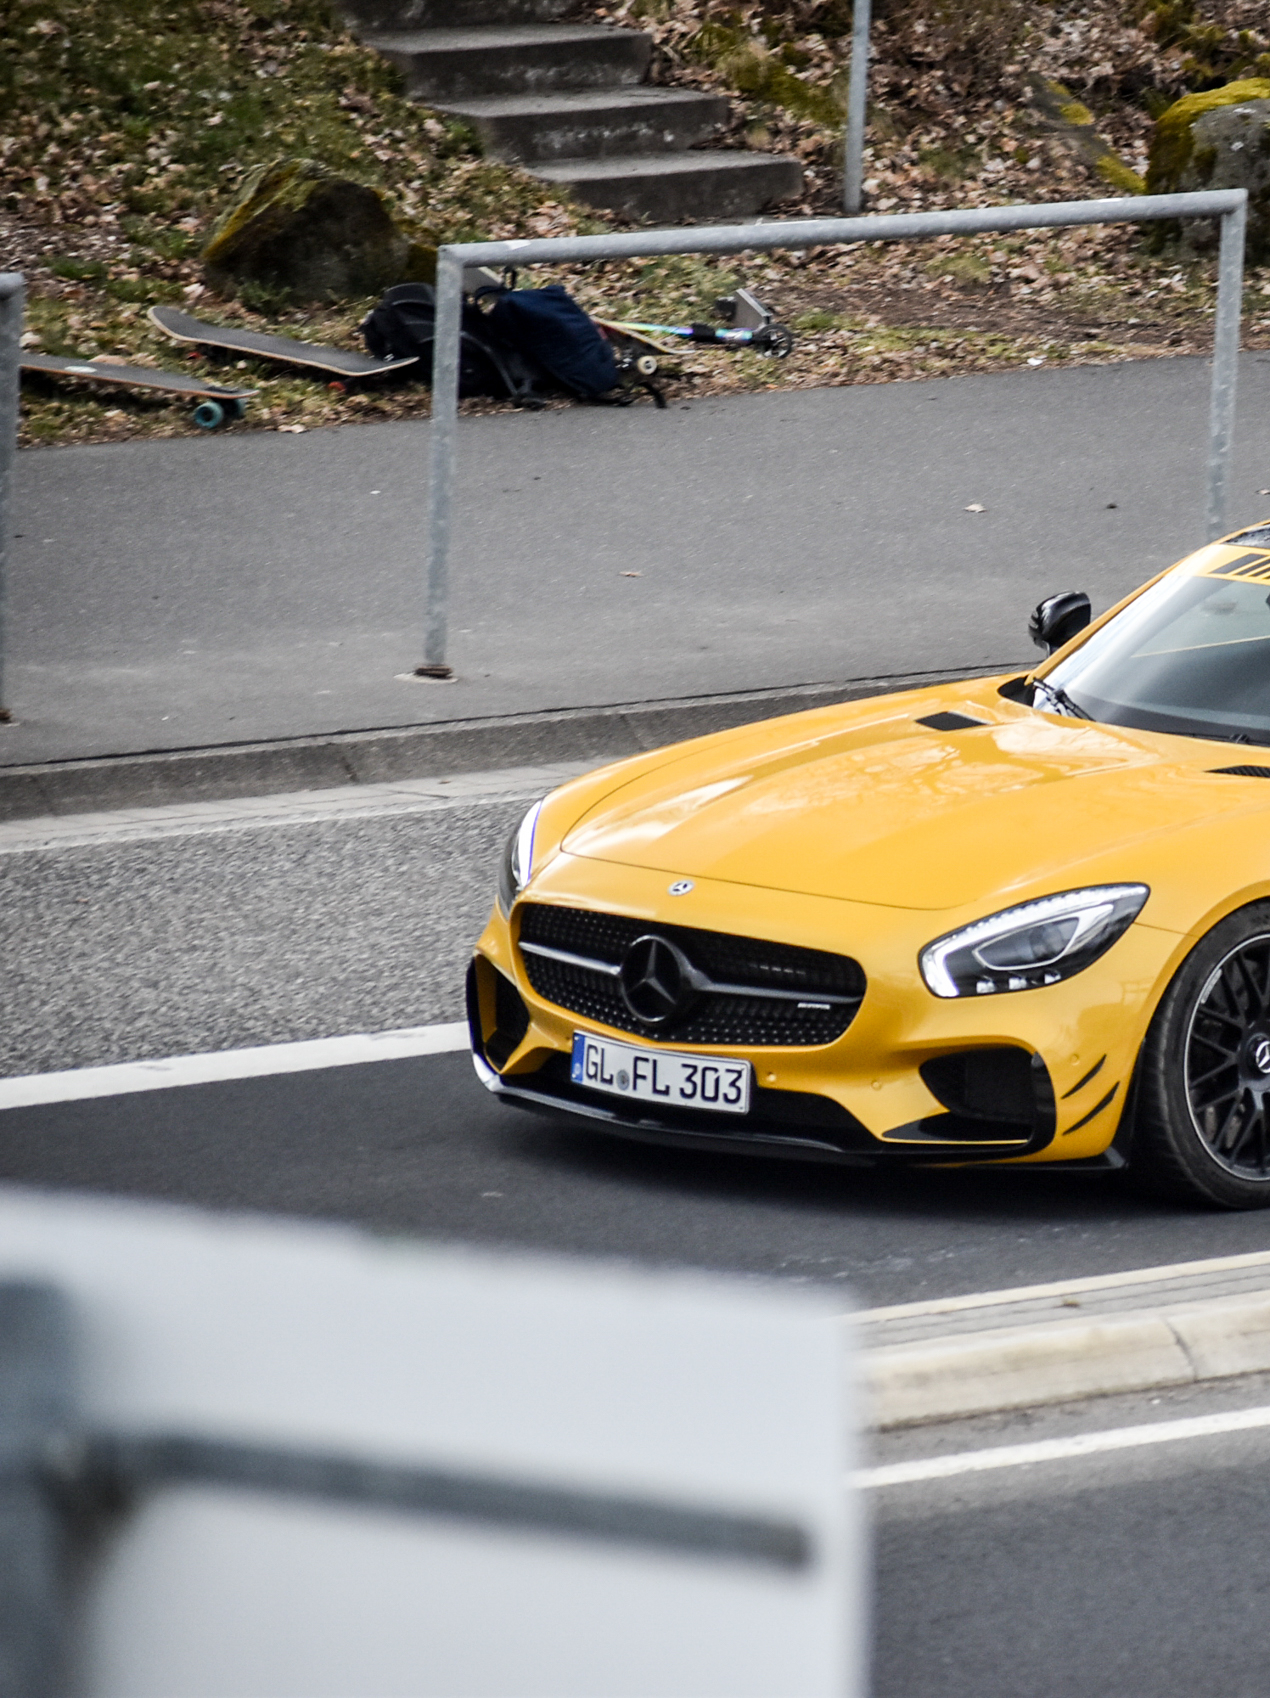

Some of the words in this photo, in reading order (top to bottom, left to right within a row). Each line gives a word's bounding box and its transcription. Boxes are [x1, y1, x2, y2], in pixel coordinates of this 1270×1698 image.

[585, 1044, 613, 1085] GL
[632, 1056, 670, 1096] FL
[679, 1063, 743, 1104] 303
